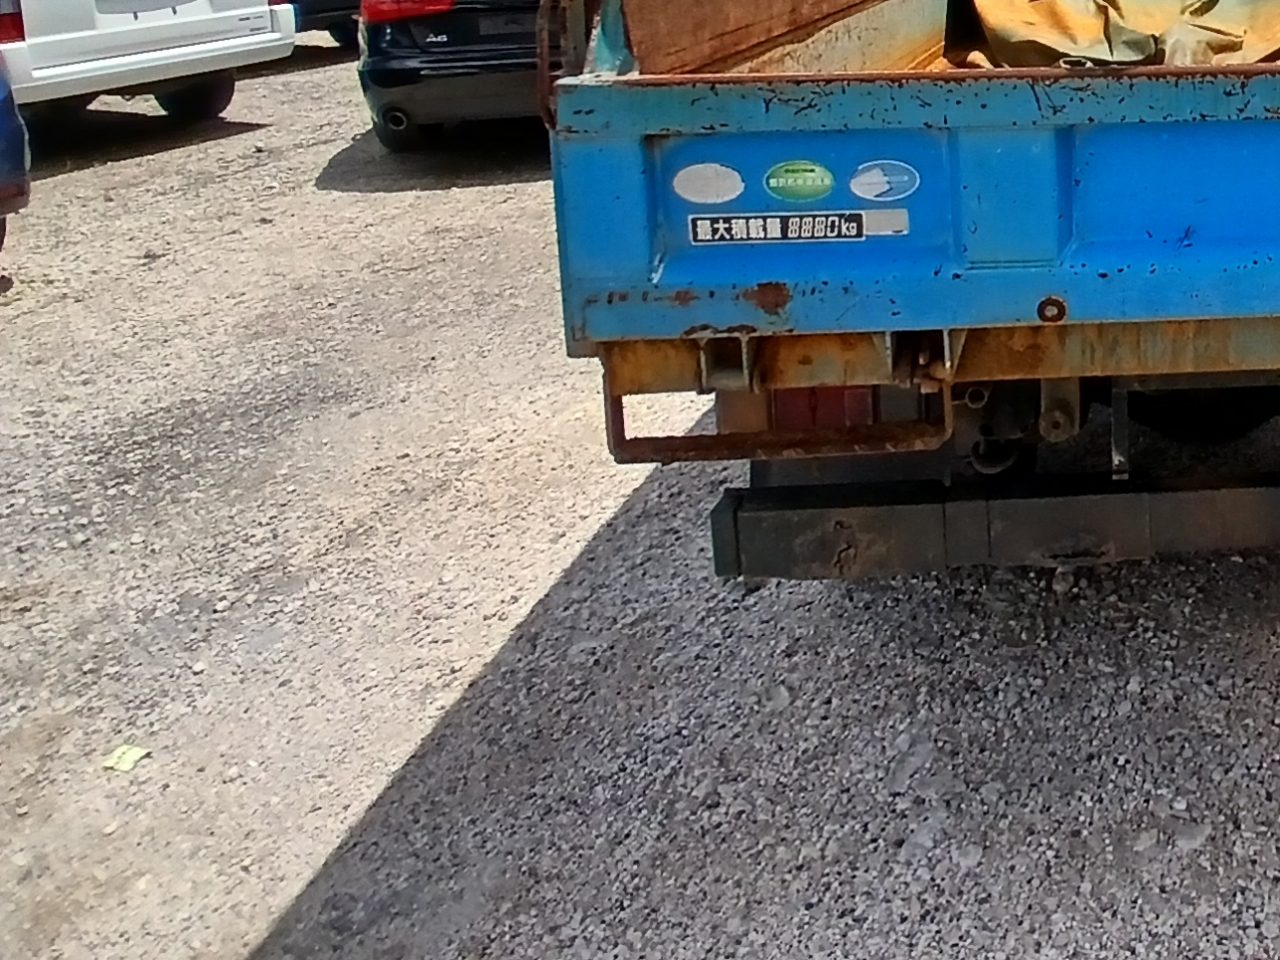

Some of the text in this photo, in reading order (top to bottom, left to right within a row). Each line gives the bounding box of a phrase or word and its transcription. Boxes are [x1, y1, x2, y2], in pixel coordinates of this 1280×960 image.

[696, 217, 783, 240] 最大積載量
